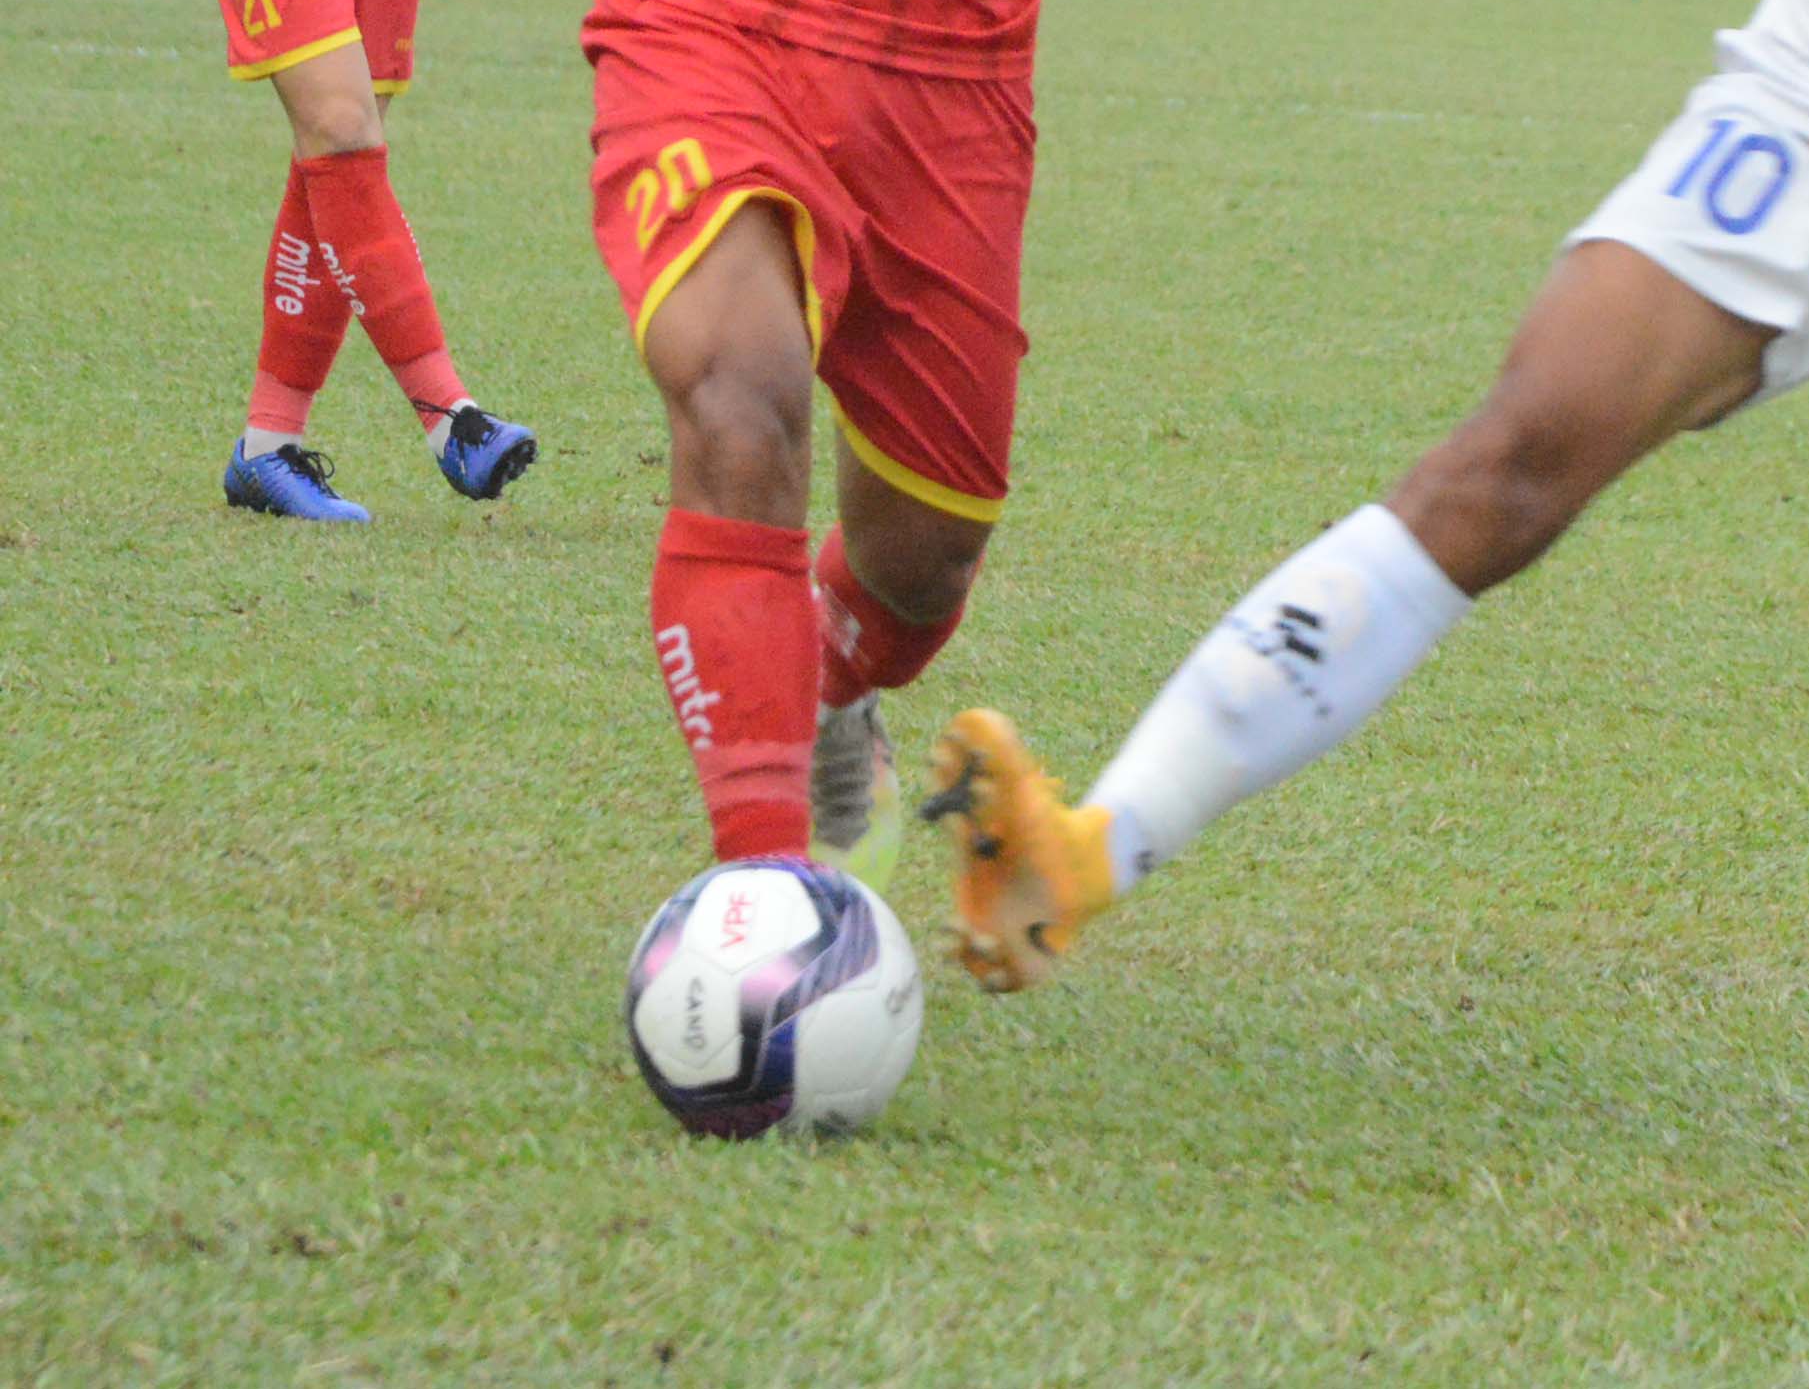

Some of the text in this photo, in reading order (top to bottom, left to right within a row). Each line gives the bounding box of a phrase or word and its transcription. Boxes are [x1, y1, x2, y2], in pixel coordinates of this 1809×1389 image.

[624, 136, 713, 252] 20
[1664, 118, 1792, 237] 10
[274, 231, 321, 316] mitre
[318, 242, 366, 316] mitre
[719, 891, 753, 949] VPF
